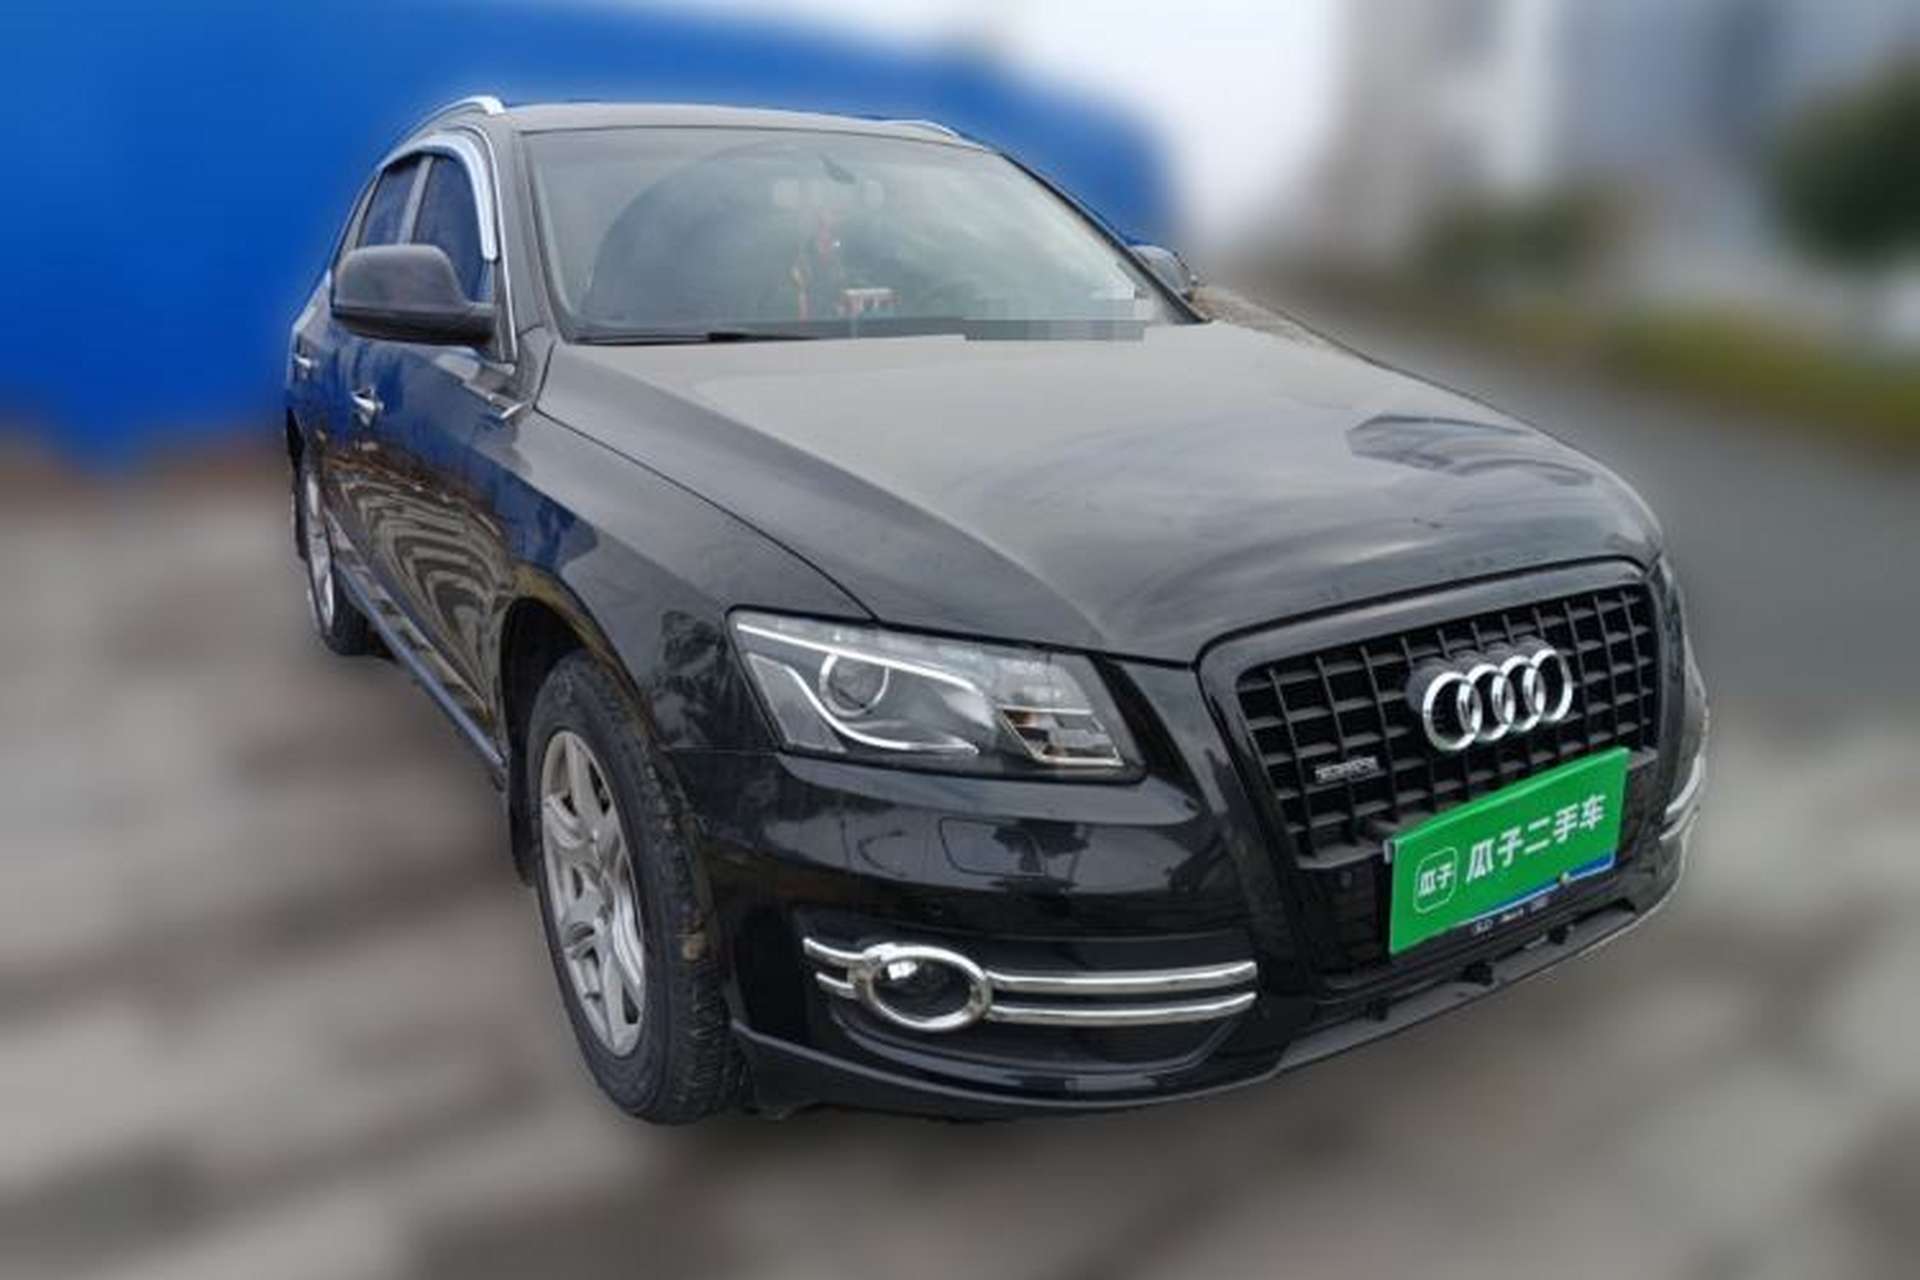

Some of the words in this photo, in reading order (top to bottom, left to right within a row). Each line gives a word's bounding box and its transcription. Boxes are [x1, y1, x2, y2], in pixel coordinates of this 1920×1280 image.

[1466, 794, 1606, 882] 瓜子二手车
[1418, 862, 1455, 897] 瓜子
